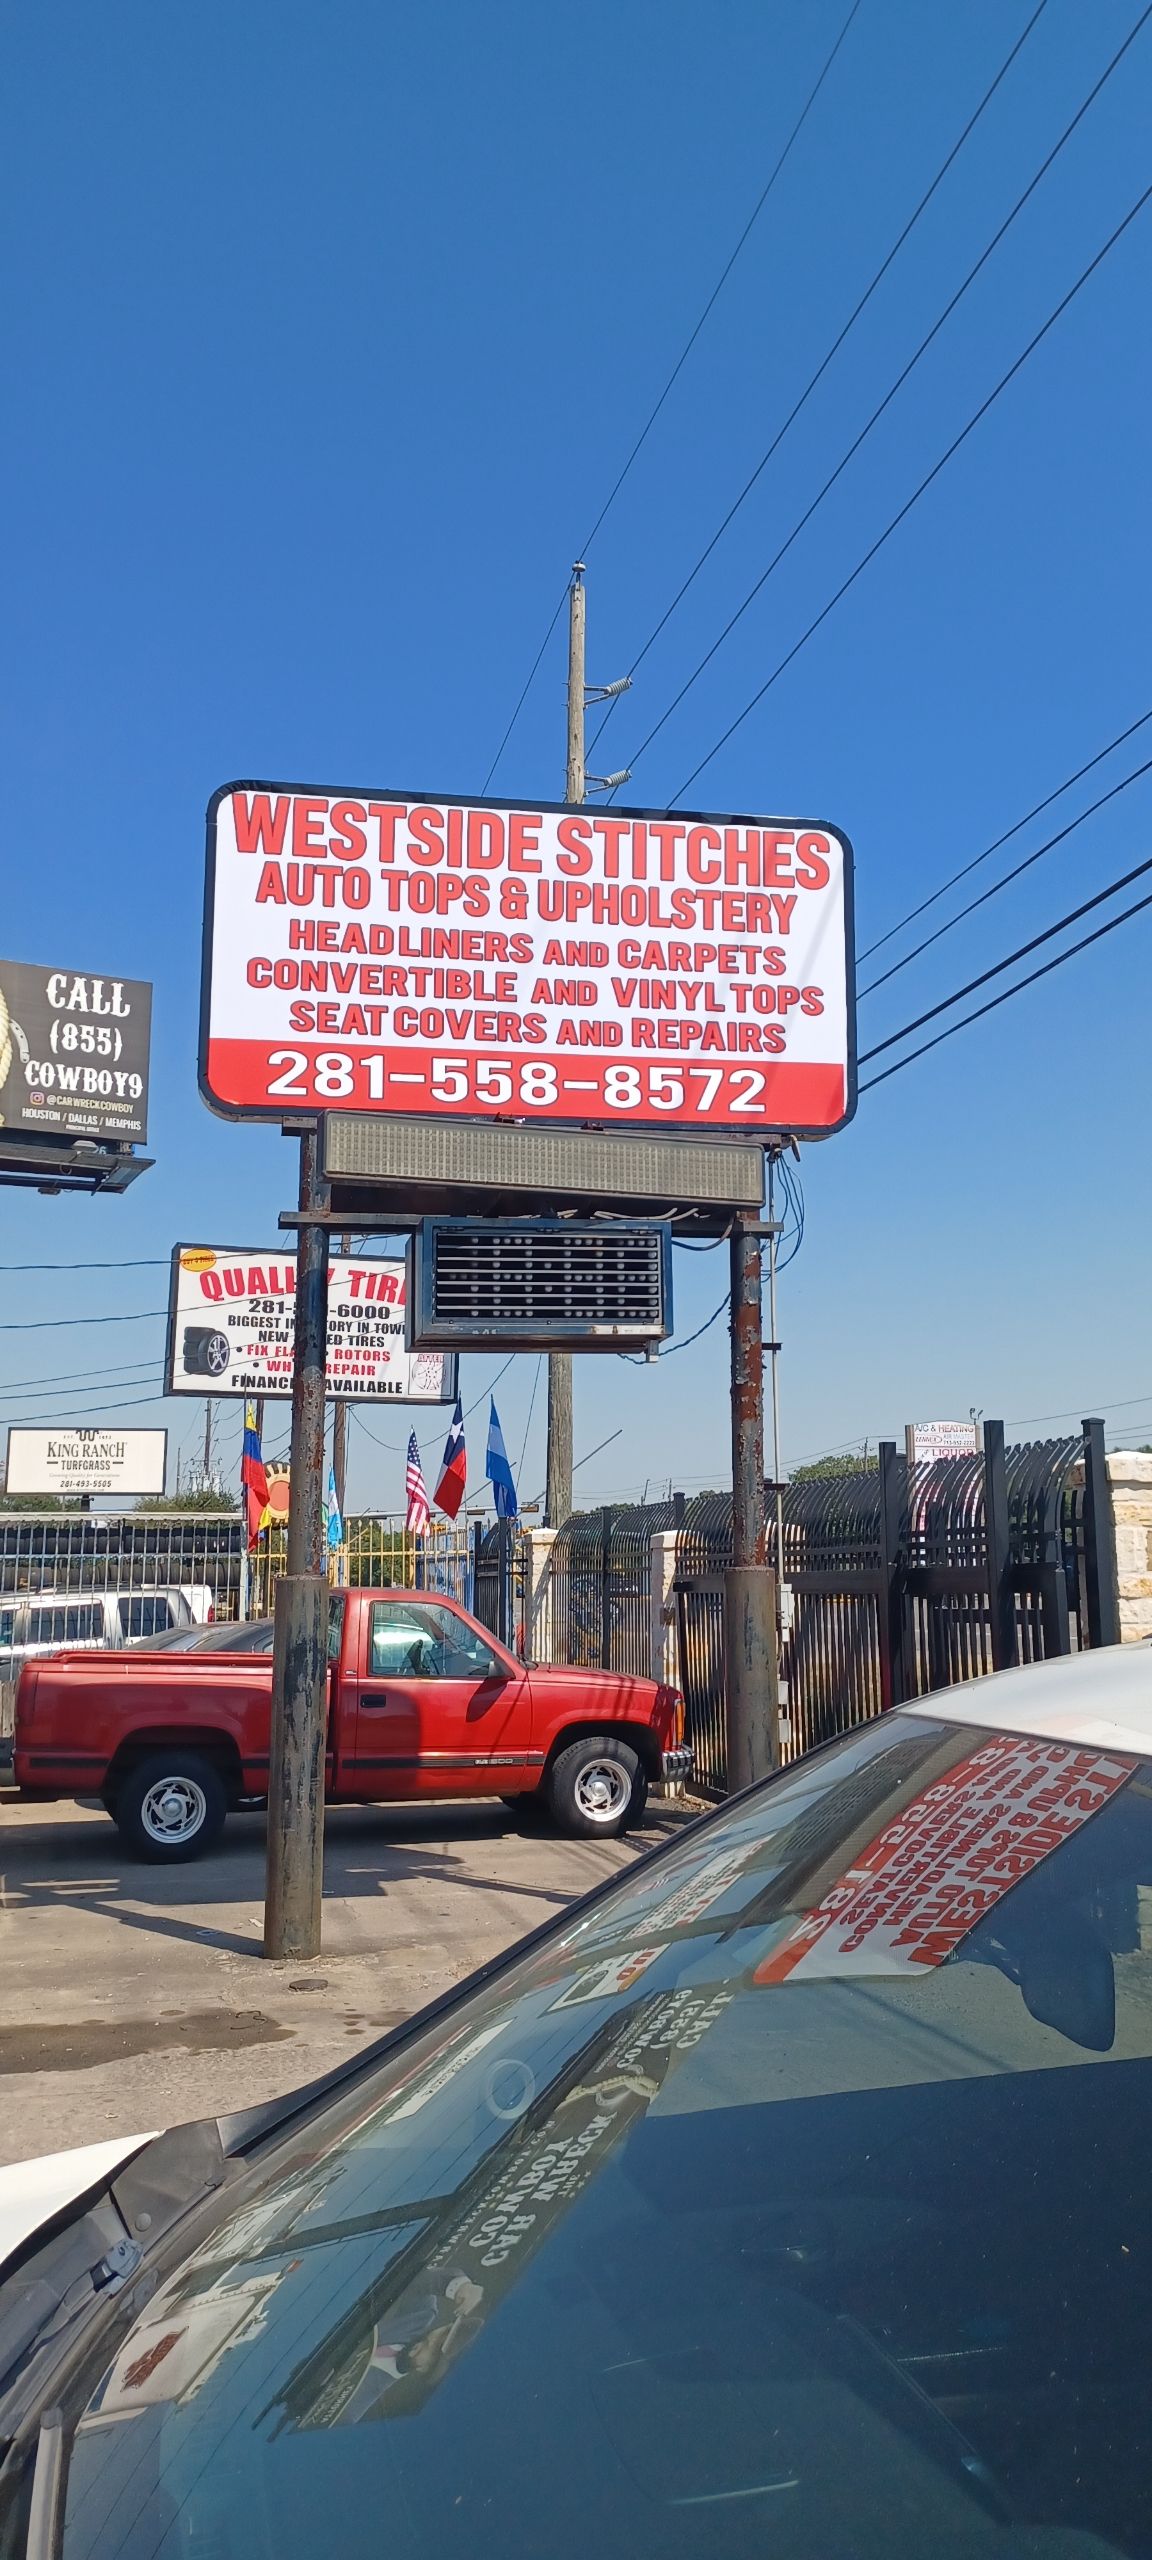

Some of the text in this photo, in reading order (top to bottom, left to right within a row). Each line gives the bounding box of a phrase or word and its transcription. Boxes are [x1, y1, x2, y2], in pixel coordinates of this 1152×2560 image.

[231, 793, 831, 890] WESTSIDE STITCHES
[255, 860, 798, 934] AUTO TOPS & UPHOLSTERY
[289, 918, 787, 976] HEADLINERS AND CARPETS
[46, 973, 131, 1018] CALL
[246, 956, 824, 1017] CONVERTIBLE AND VINYL TOPS
[49, 1018, 123, 1062] (855)
[289, 1000, 787, 1054] SEAT COVERS AND REPAIRS
[24, 1059, 144, 1099] COWBOY9
[266, 1048, 767, 1113] 281-558-8572
[22, 1107, 61, 1121] HOUSTON
[68, 1113, 98, 1126] DALLAS
[105, 1117, 142, 1131] MEMPHIS
[199, 1266, 335, 1302] QUALI
[227, 1315, 281, 1328] BIGGEST
[357, 1321, 370, 1334] IN
[248, 1299, 391, 1320] 281--6000
[247, 1344, 269, 1356] FIX
[334, 1348, 391, 1362] ROTORS
[258, 1330, 289, 1343] NEW
[347, 1335, 385, 1348] TIRES
[325, 1379, 403, 1394] AVAILABLE
[938, 1424, 974, 1433] HEATING
[47, 1441, 125, 1458] KING RANCH
[61, 1460, 111, 1470] TURFGRASS
